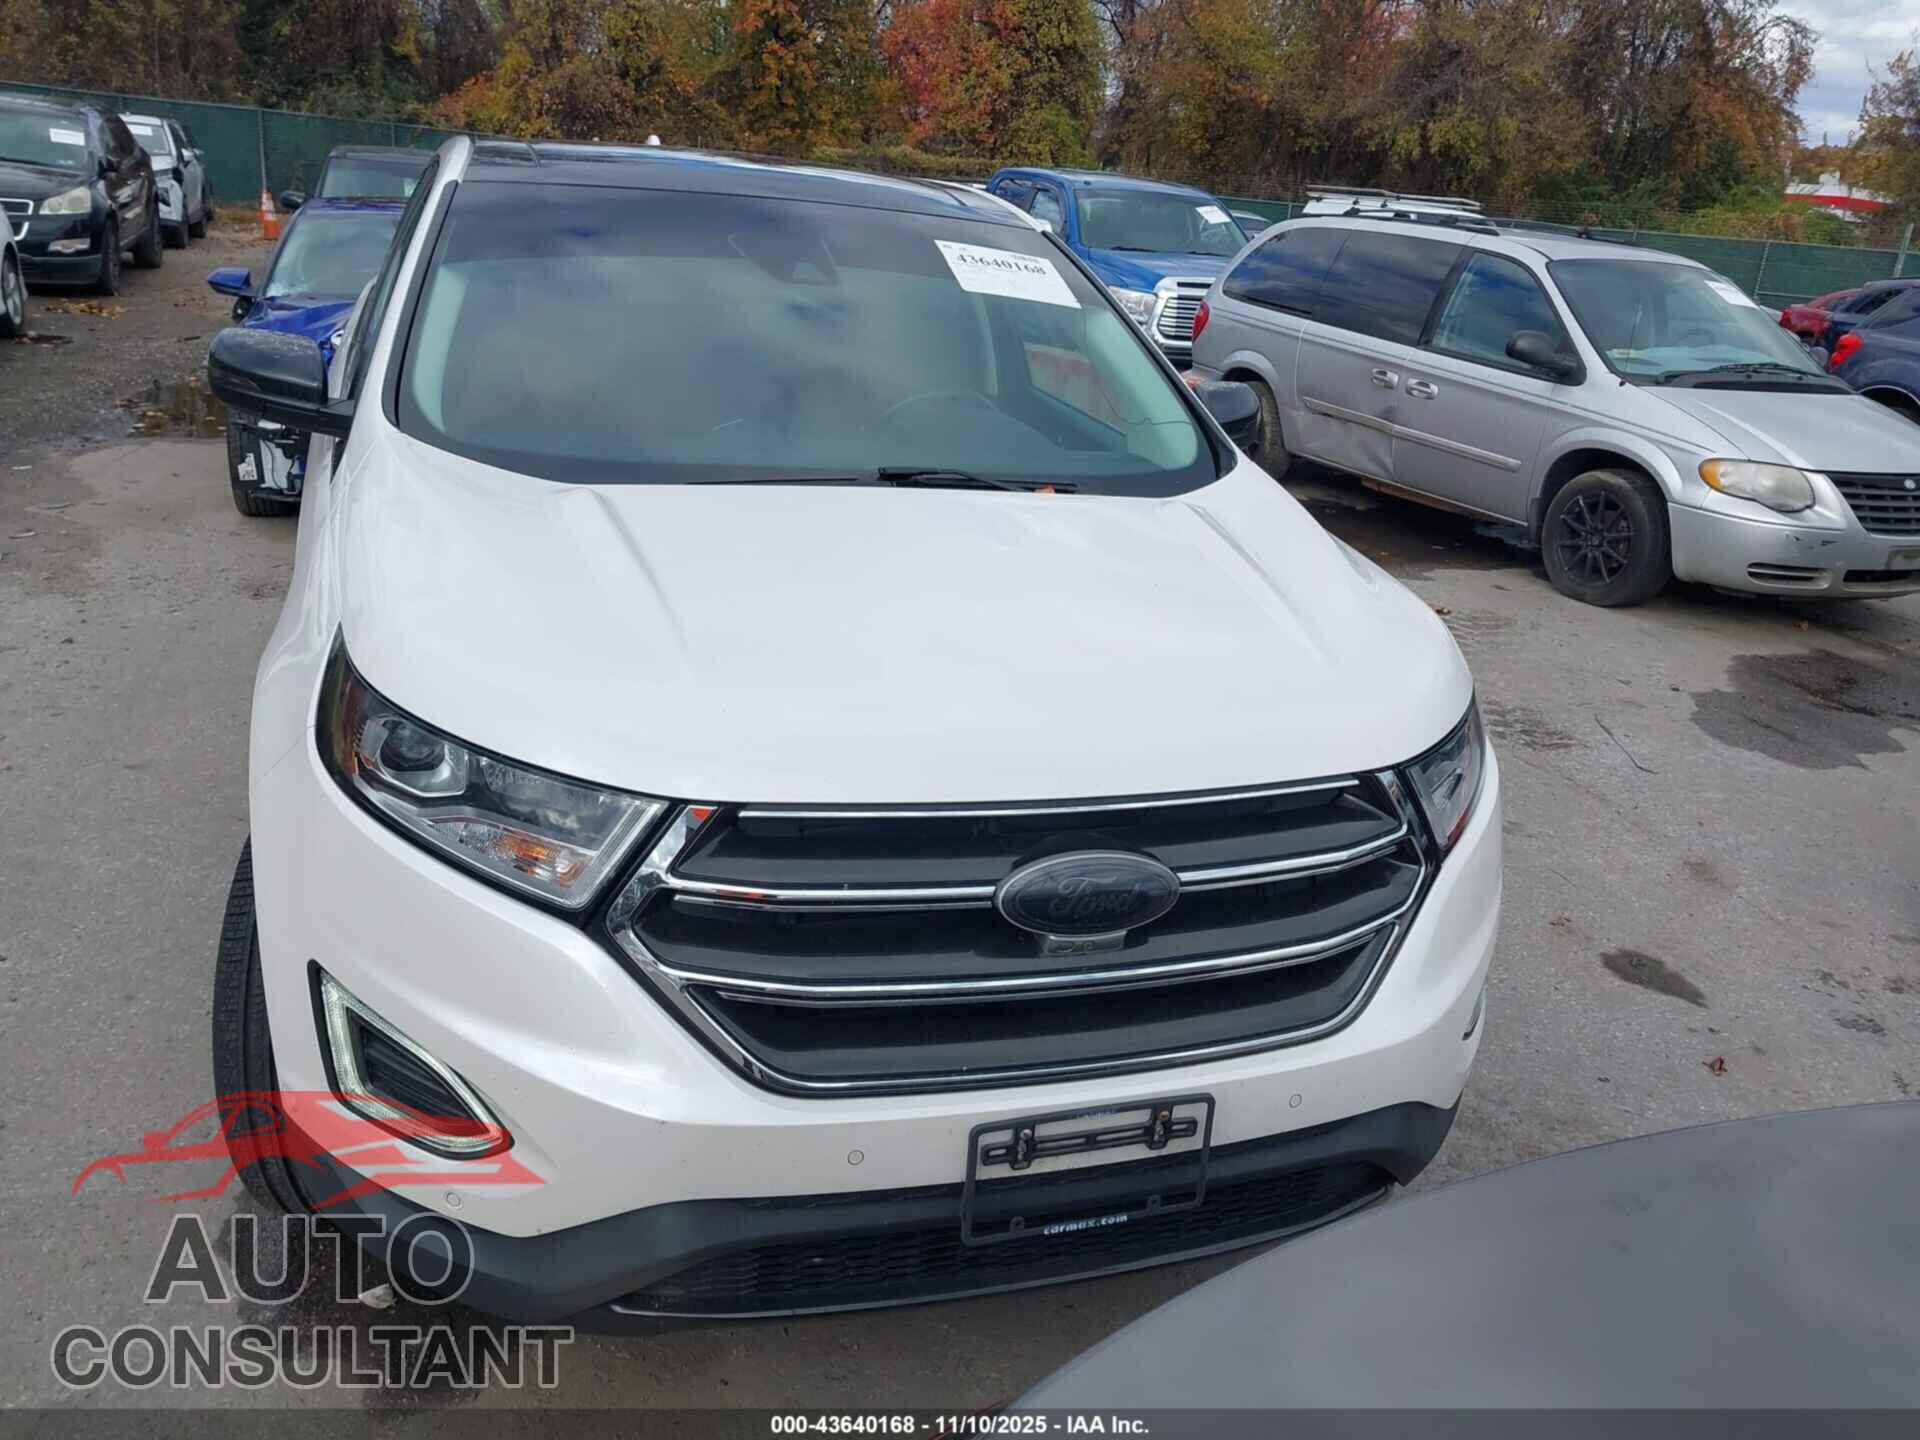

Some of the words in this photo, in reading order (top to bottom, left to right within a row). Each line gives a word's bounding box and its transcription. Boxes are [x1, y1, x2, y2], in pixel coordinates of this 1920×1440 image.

[957, 253, 1047, 276] 43640168
[1053, 875, 1147, 916] Ford
[1043, 1213, 1129, 1236] carmax.com
